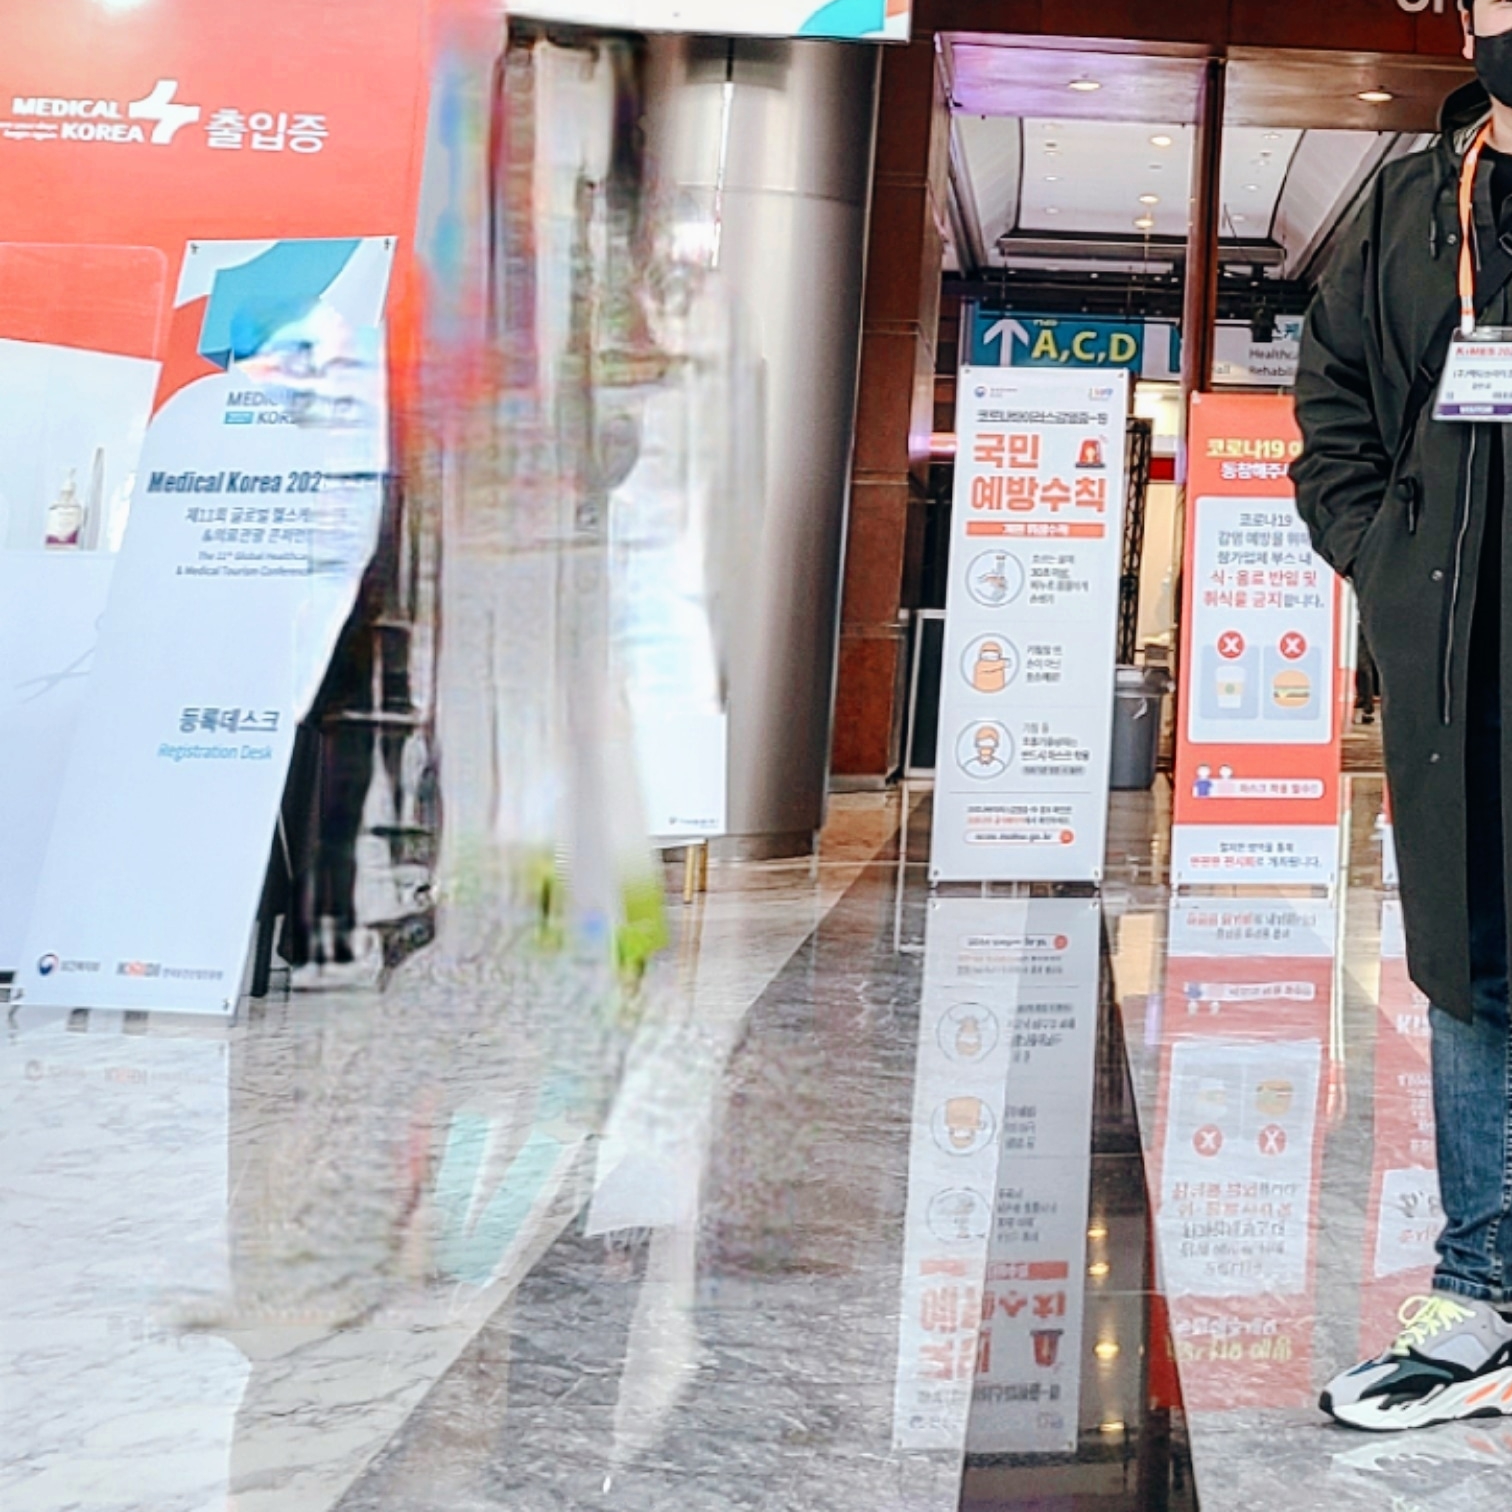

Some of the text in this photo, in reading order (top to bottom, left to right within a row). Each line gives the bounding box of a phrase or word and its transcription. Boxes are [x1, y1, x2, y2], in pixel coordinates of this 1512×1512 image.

[12, 97, 123, 119] MEDICAL
[60, 121, 145, 144] KOREA
[204, 108, 329, 153] 출입증
[973, 433, 1040, 469] 국민
[1206, 438, 1286, 460] 코로나19
[147, 471, 323, 494] Medical Korea 202
[971, 475, 1107, 513] 예방수칙
[1239, 512, 1293, 528] 코로나19
[179, 707, 281, 734] 등록데스크
[157, 743, 273, 762] Registration Desk
